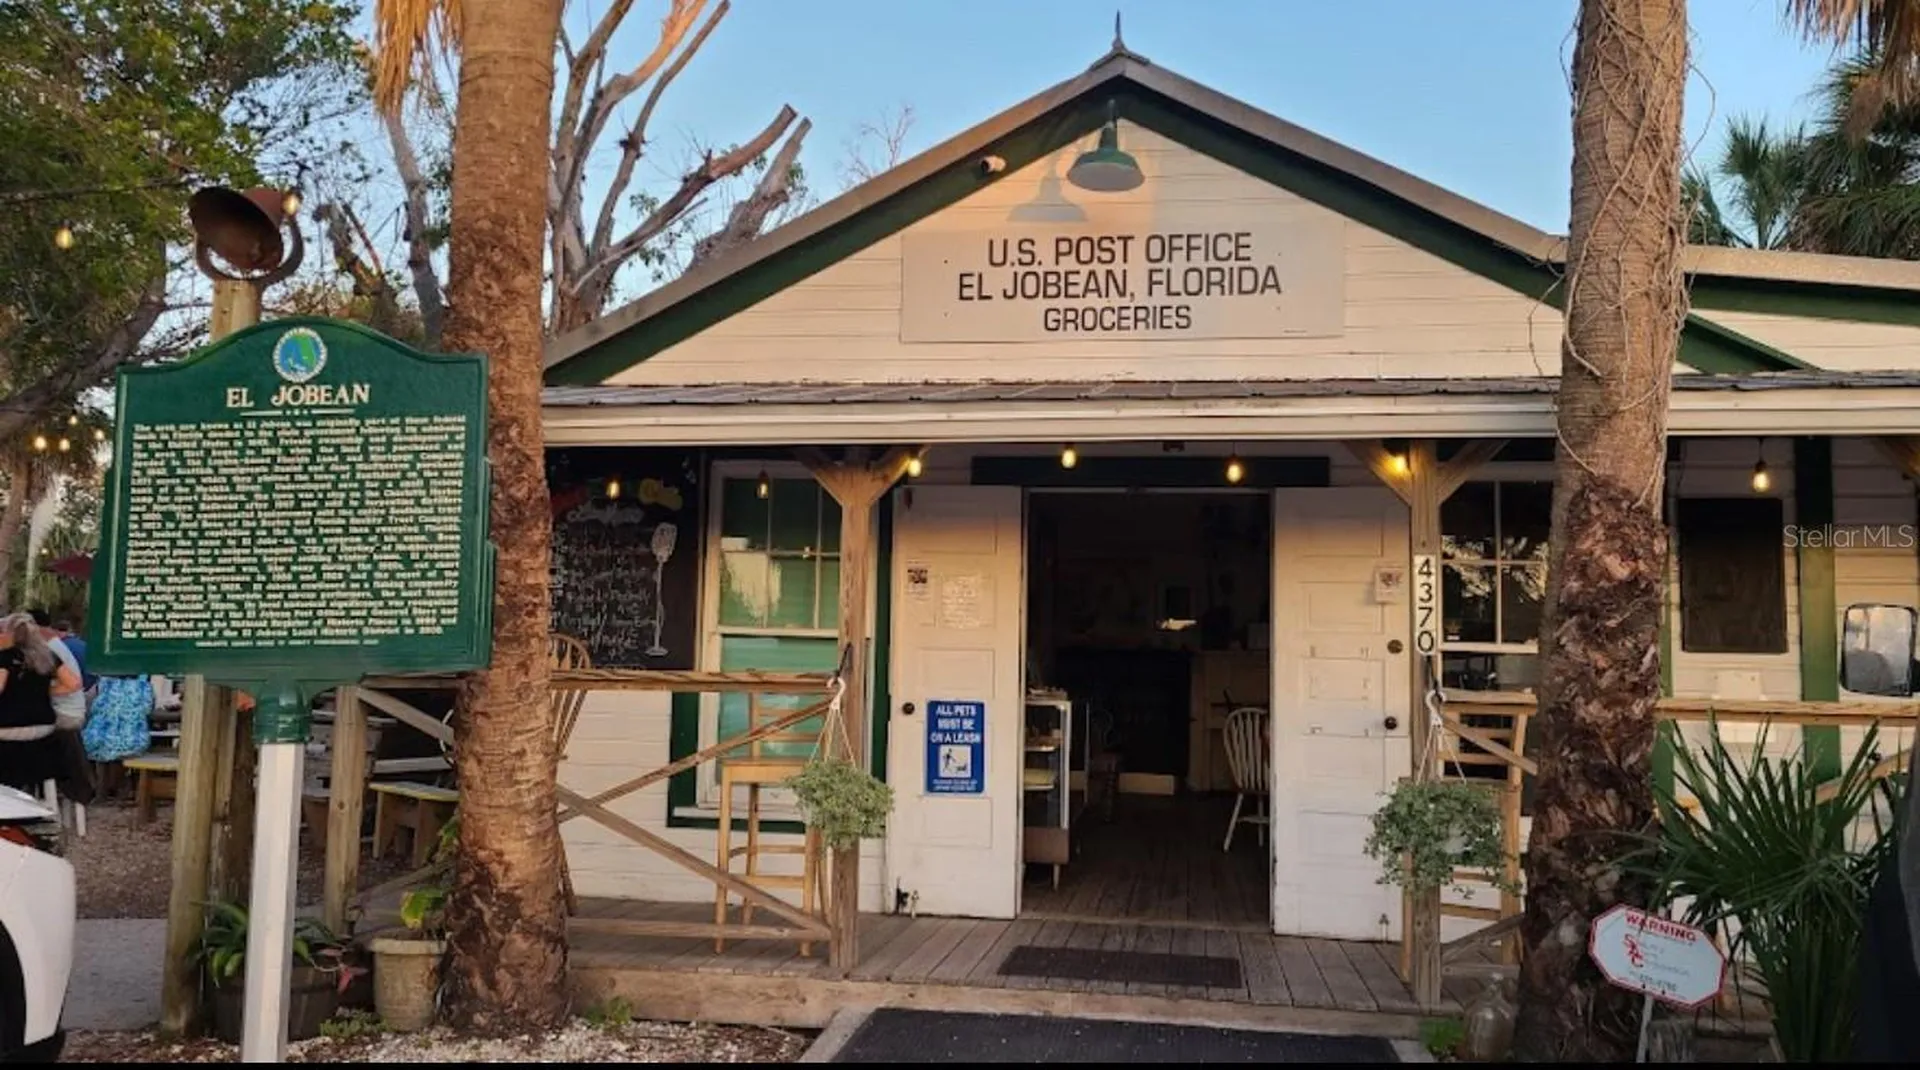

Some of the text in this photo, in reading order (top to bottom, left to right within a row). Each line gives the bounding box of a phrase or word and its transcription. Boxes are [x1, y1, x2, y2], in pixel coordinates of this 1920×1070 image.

[987, 232, 1252, 268] U.S. POST OFFICE
[957, 265, 1282, 303] EL JOBEAN, FLORIDA
[1043, 304, 1192, 332] GROCERIES
[226, 383, 371, 408] EL JOBEAN
[1416, 556, 1435, 654] 4370
[935, 705, 976, 716] ALL PETS
[938, 718, 974, 730] MUST BE
[930, 731, 981, 743] ON A LEASH
[1625, 913, 1697, 942] WARNING
